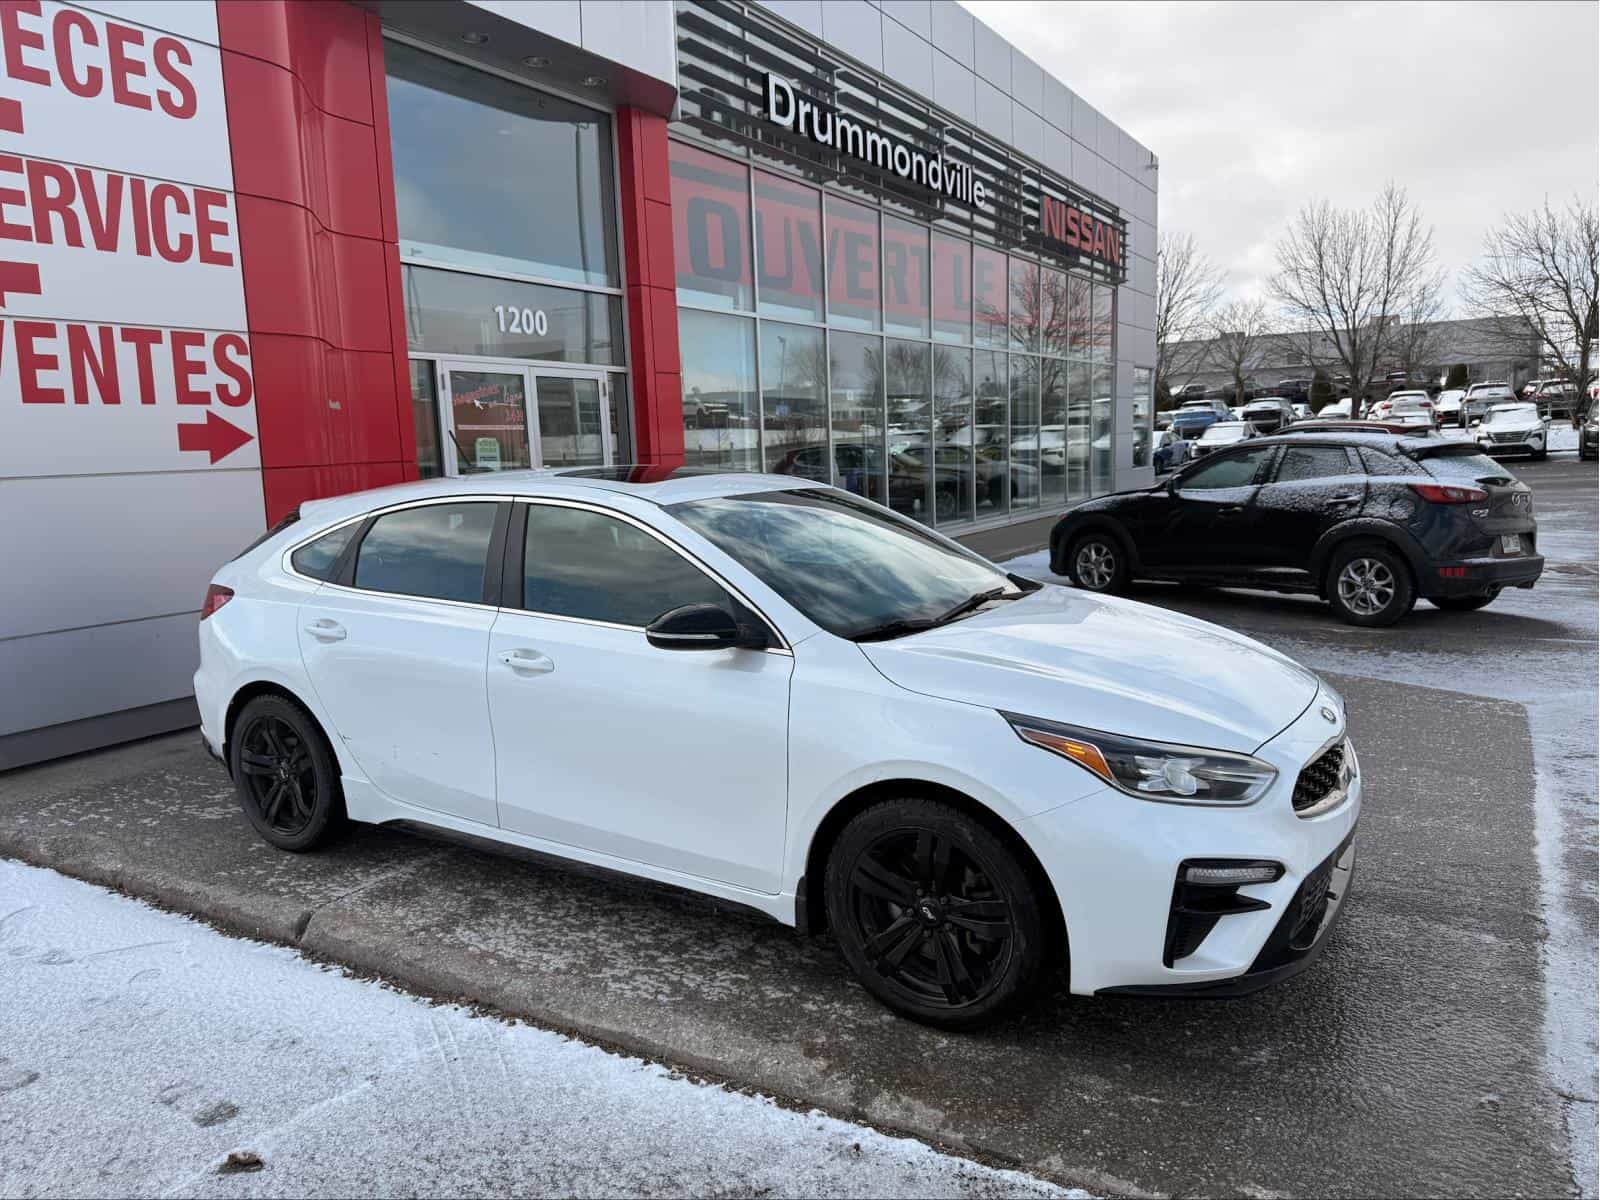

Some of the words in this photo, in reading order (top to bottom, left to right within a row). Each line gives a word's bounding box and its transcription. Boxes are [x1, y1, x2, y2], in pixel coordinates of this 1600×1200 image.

[768, 72, 986, 208] Drummondville
[0, 154, 234, 267] ERVICE
[687, 196, 937, 308] OUVERT
[1042, 195, 1121, 264] NISSAN
[494, 305, 548, 337] 1200
